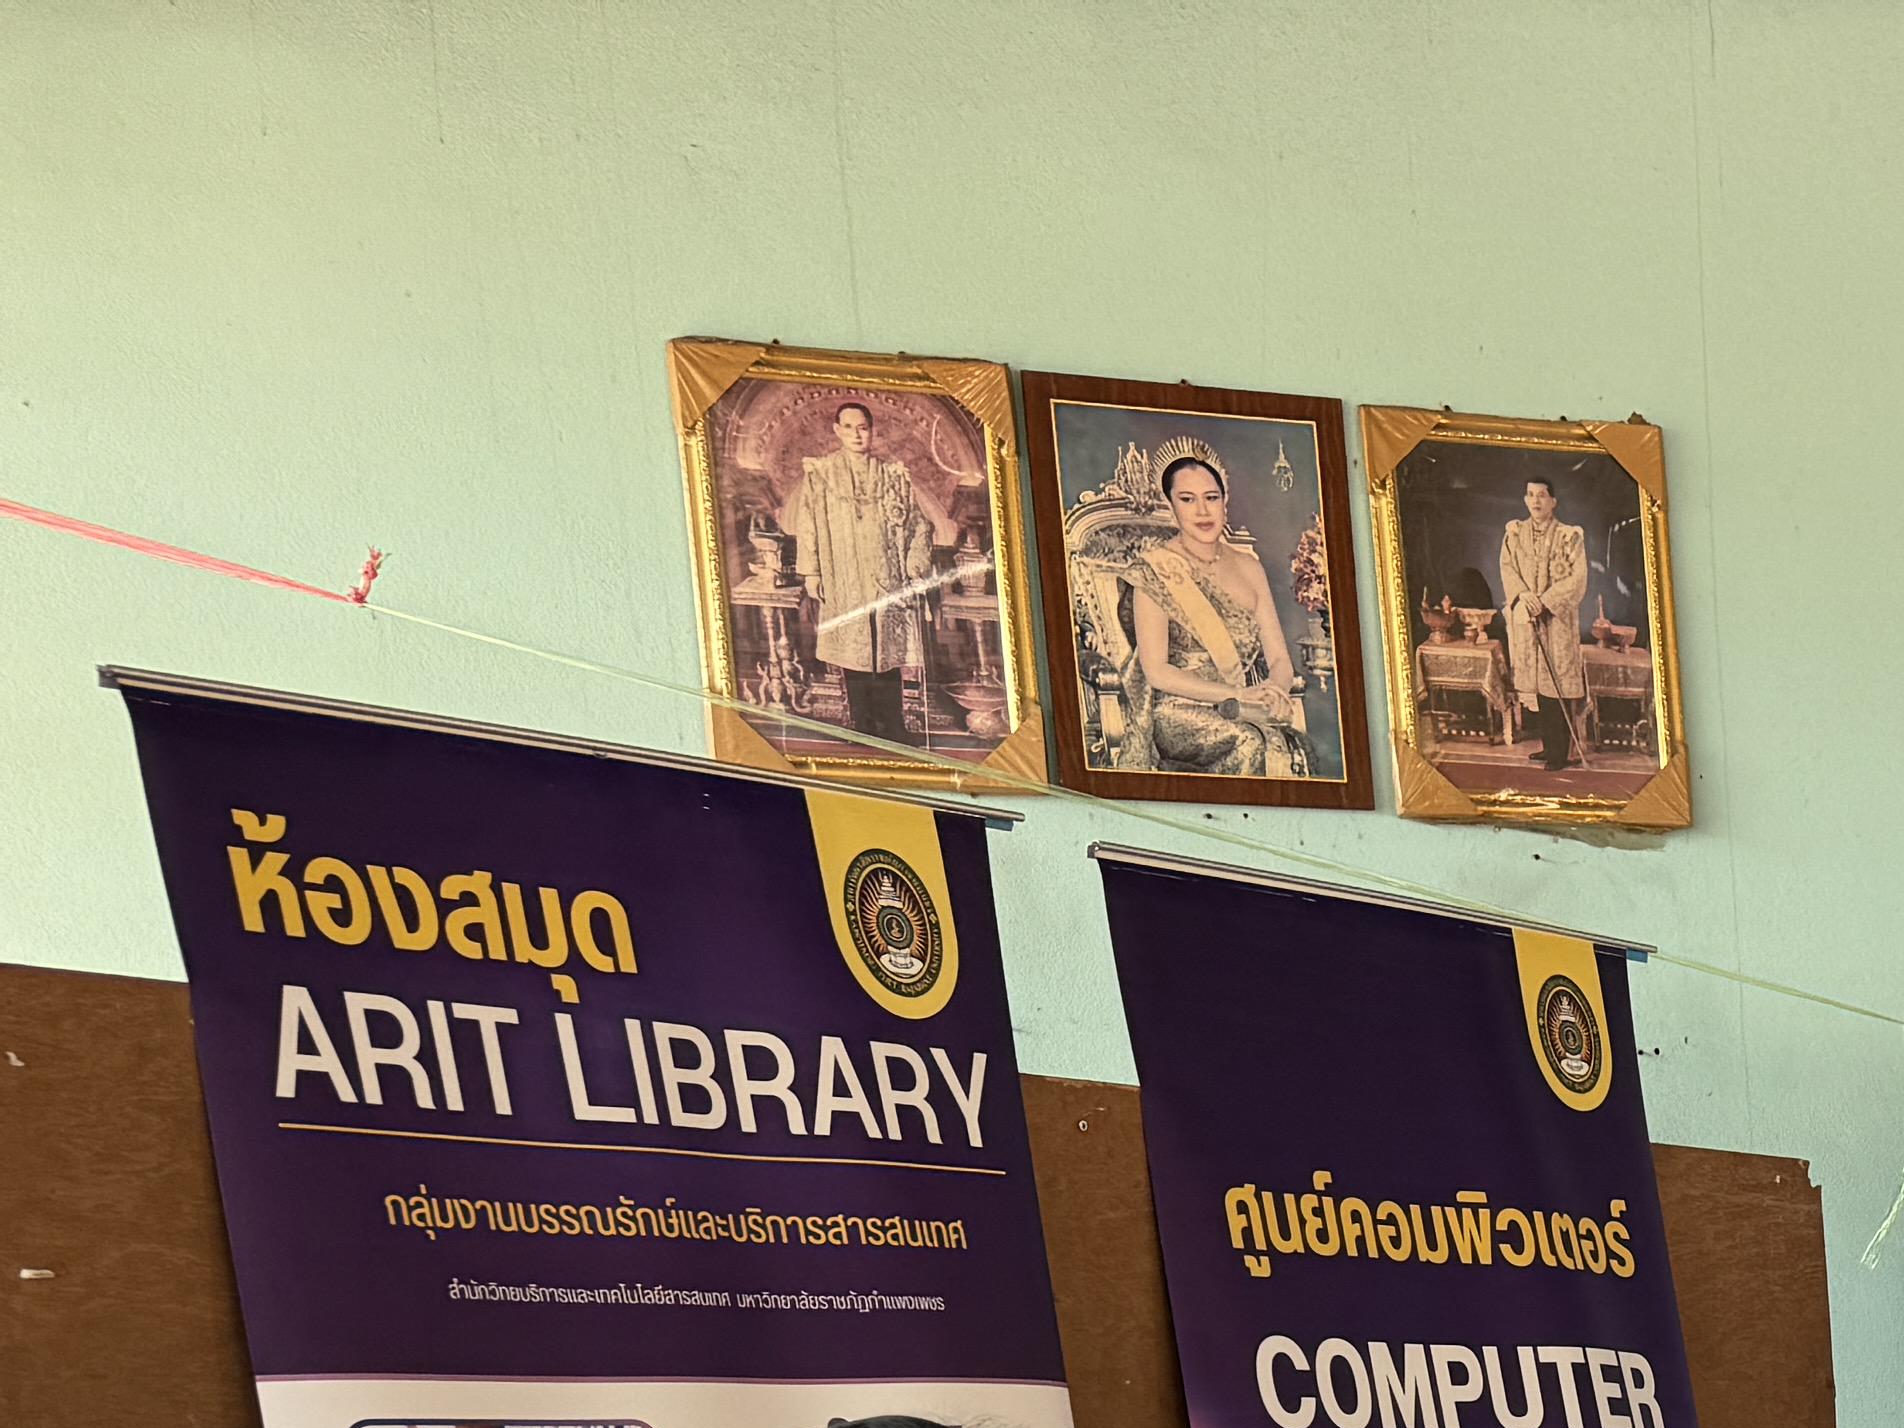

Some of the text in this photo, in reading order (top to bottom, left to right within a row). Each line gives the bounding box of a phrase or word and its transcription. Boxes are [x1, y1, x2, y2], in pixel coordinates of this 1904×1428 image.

[226, 808, 637, 1002] ห้องสมุด
[275, 985, 987, 1148] ARIT LIBRARY
[385, 1184, 967, 1252] กลุ่มงานบรรณรักษ์และบริการสารสนเทศ
[1224, 1170, 1636, 1279] ศูนย์คอมพิวเตอร์
[449, 1278, 731, 1308] สำนักวิทยบริการและเทคโนโลยีสารสนเทศ
